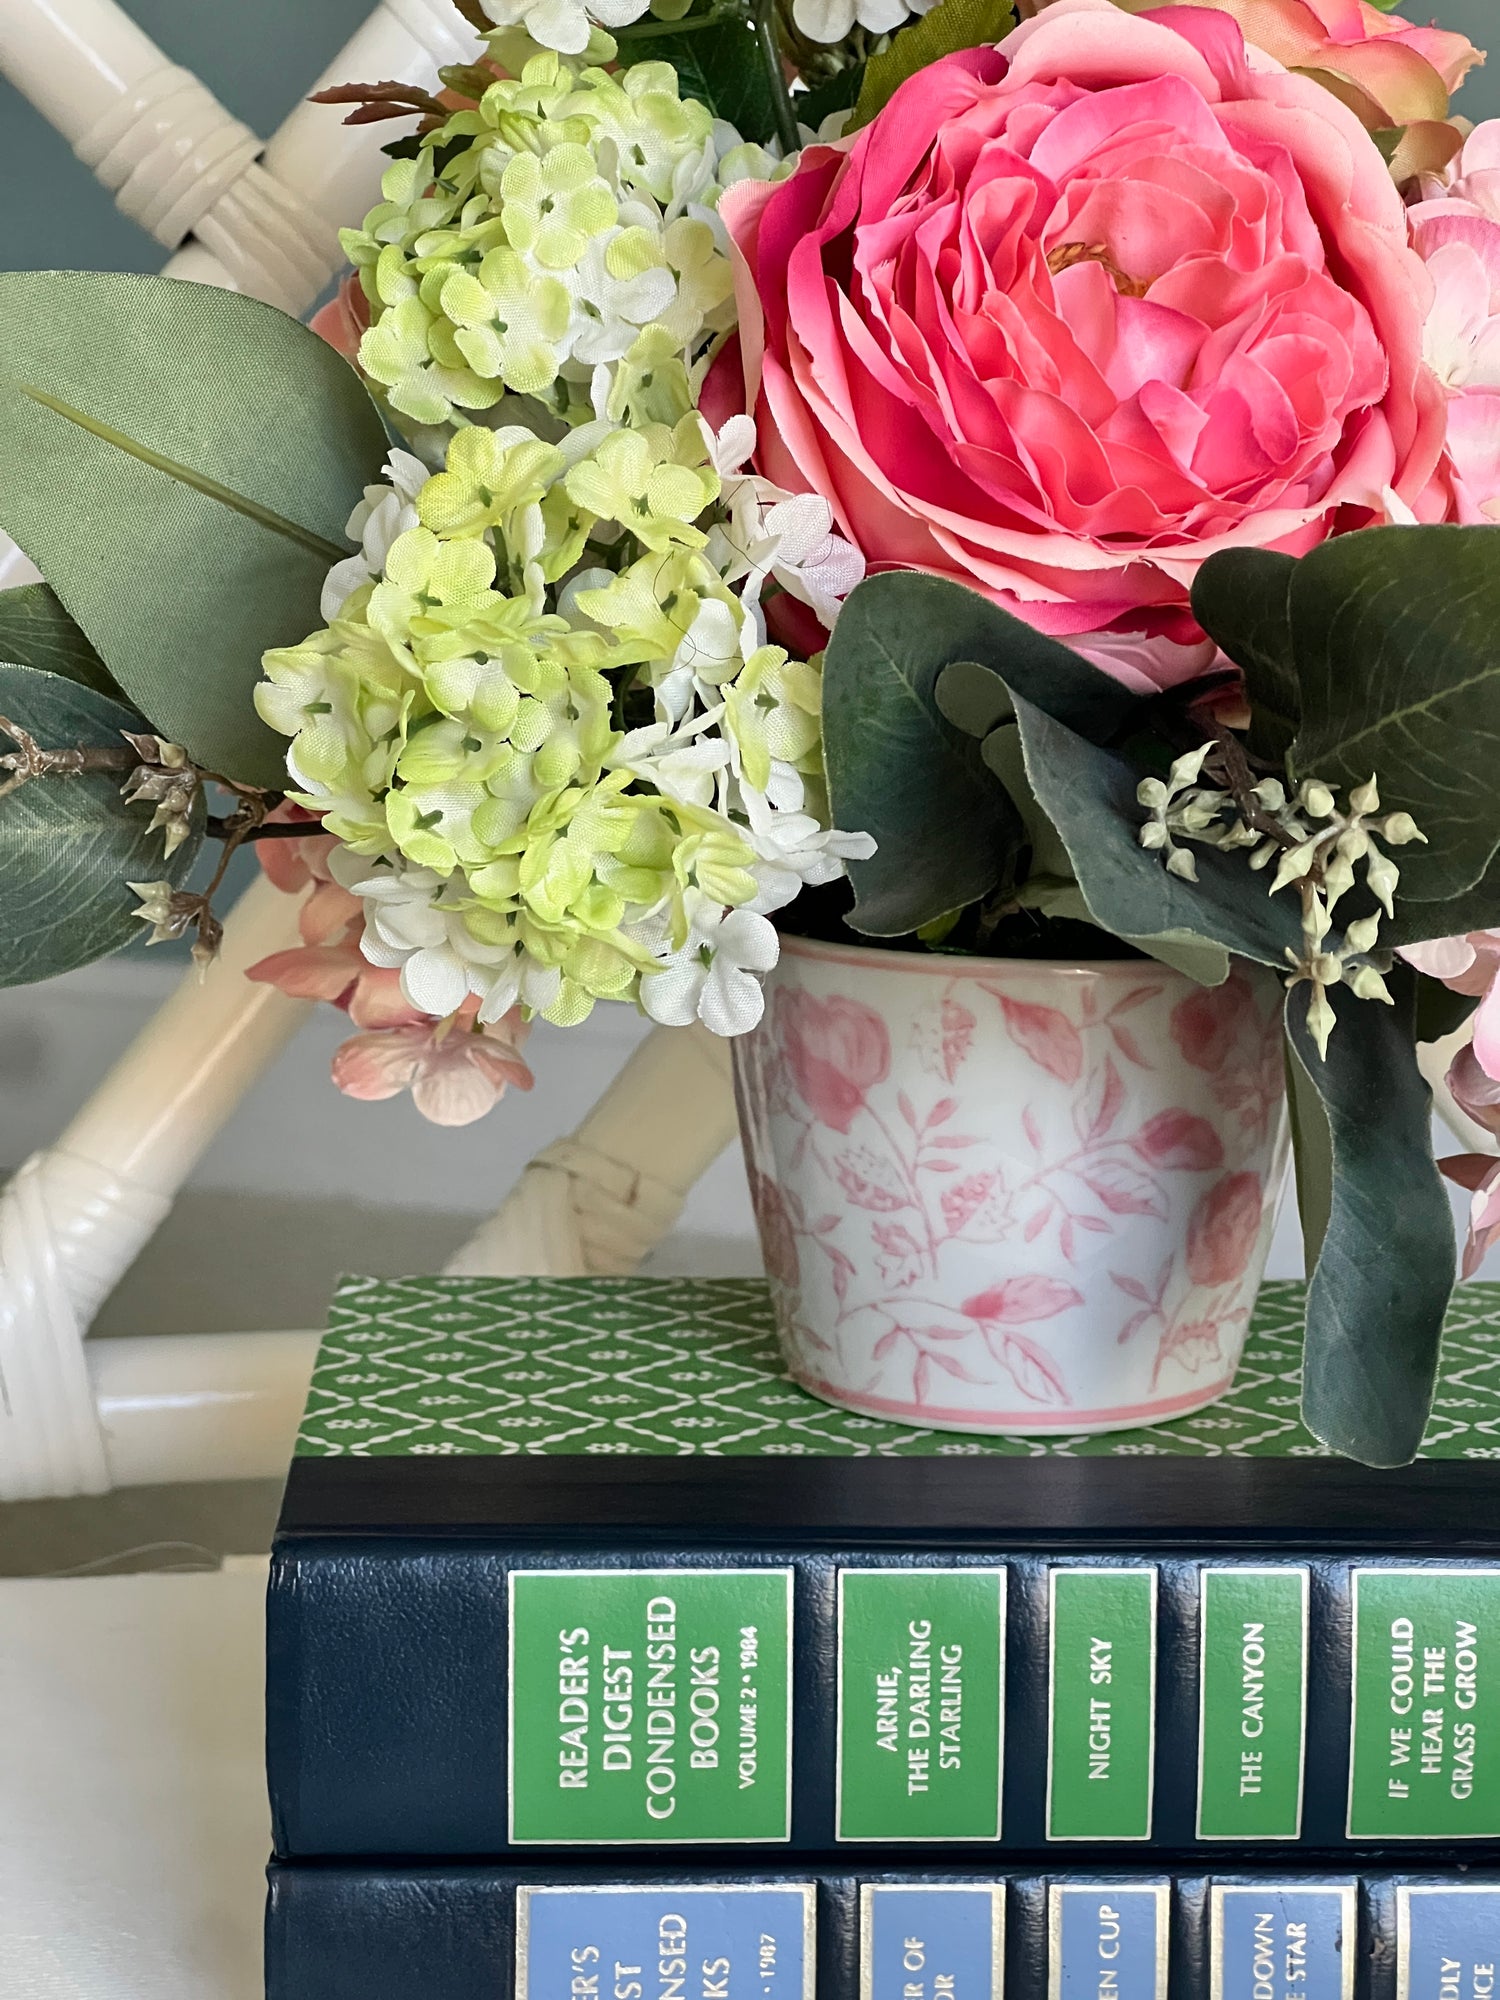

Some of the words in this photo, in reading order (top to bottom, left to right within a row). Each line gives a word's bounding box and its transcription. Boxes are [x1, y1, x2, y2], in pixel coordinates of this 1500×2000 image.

[739, 1625, 758, 1669] 1984
[908, 1619, 932, 1739] DARLING
[1089, 1637, 1113, 1684] SKY
[1241, 1623, 1265, 1738] CANYON
[1390, 1617, 1414, 1715] COULD
[1423, 1647, 1446, 1697] THE
[1454, 1620, 1478, 1710] GROW
[559, 1627, 590, 1788] READER'S
[602, 1644, 633, 1770] DIGEST
[646, 1596, 677, 1819] CONDENSED
[690, 1646, 720, 1769] BOOKS
[739, 1687, 757, 1699] 2
[876, 1667, 903, 1752] ARNIE,
[939, 1644, 963, 1769] STARLING
[738, 1703, 757, 1789] VOLUME
[908, 1748, 929, 1796] THE
[1088, 1698, 1112, 1779] NIGHT
[1240, 1751, 1263, 1797] THE
[1390, 1728, 1412, 1766] WE
[1420, 1707, 1444, 1774] HEAR
[1450, 1723, 1476, 1800] GRASS
[1388, 1778, 1410, 1798] IF
[759, 1933, 777, 1978] 1987
[903, 1936, 925, 1971] OF
[1098, 1904, 1121, 1959] CUP
[1253, 1913, 1275, 1999] DOWN
[1285, 1922, 1308, 1981] STAR
